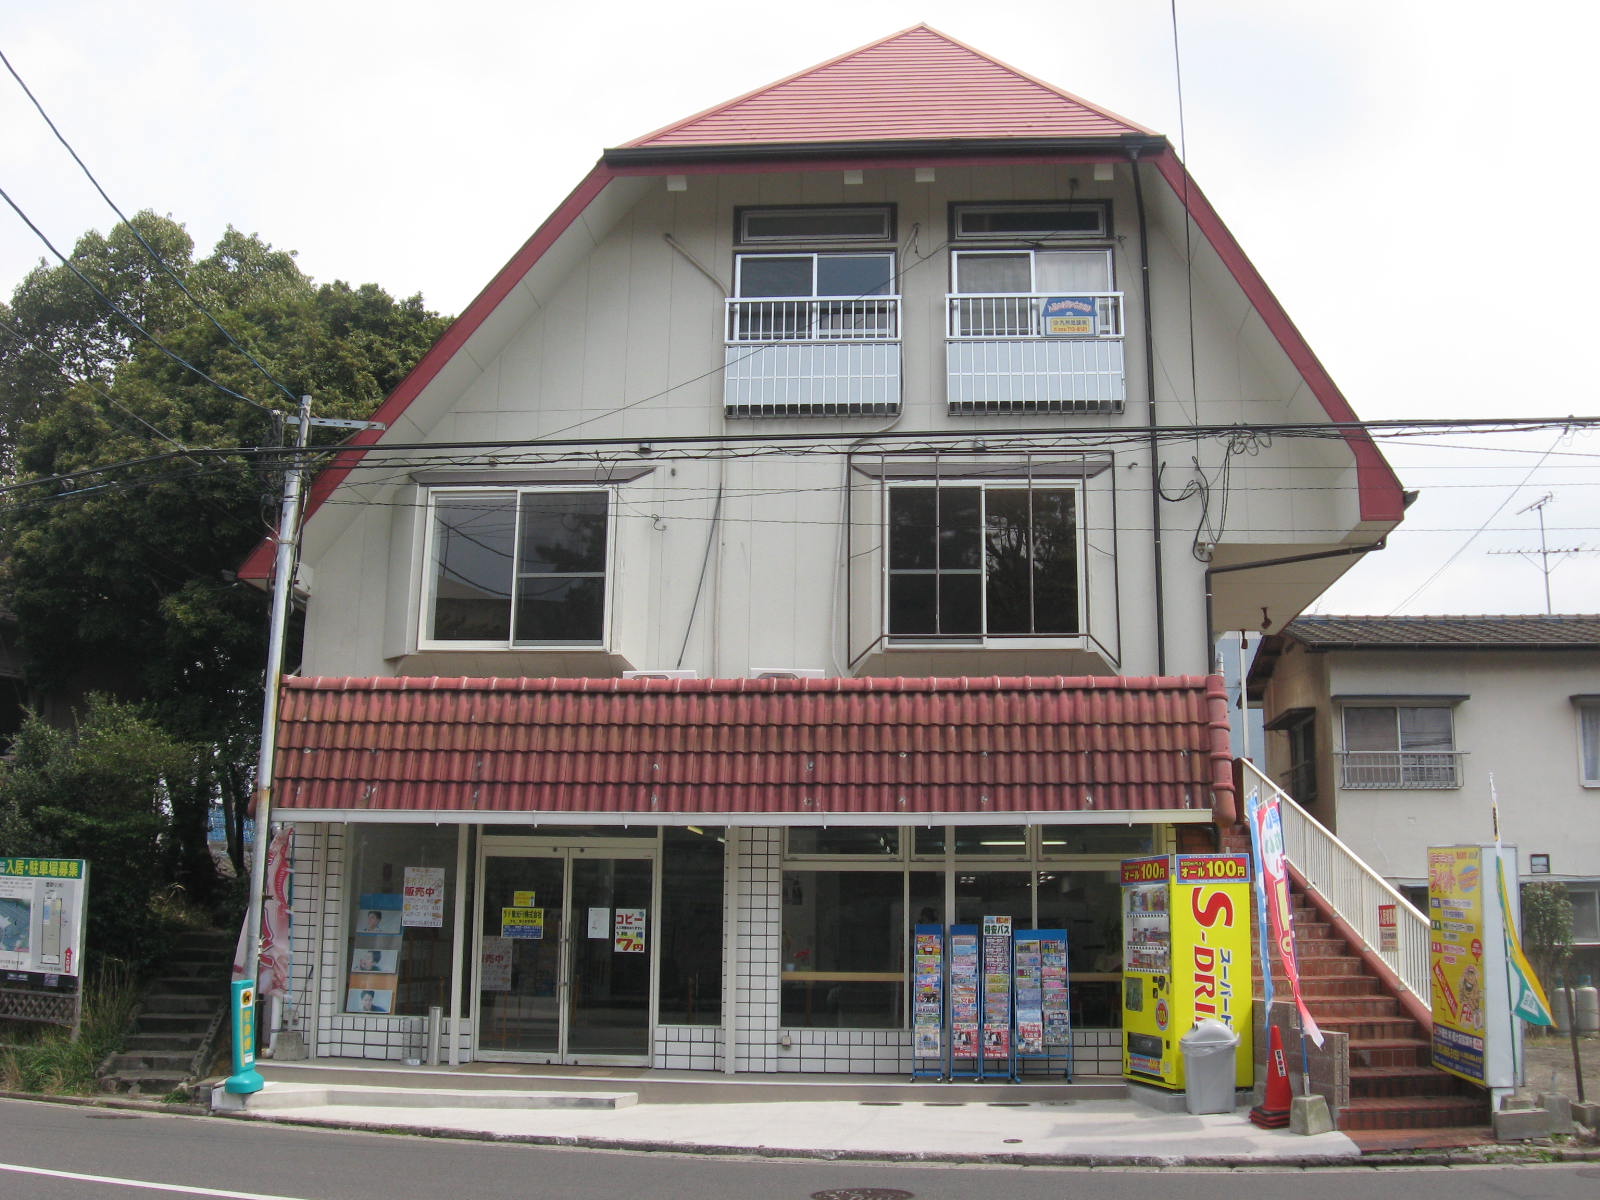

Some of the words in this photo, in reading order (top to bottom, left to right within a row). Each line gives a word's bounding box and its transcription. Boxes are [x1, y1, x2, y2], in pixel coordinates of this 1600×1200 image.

[6, 859, 79, 877] 入居・駐車場募集
[1141, 862, 1165, 880] 100円
[1181, 867, 1205, 878] オール
[1206, 860, 1246, 878] 100円
[405, 886, 435, 898] 販売中
[1192, 886, 1234, 1023] S-DRI
